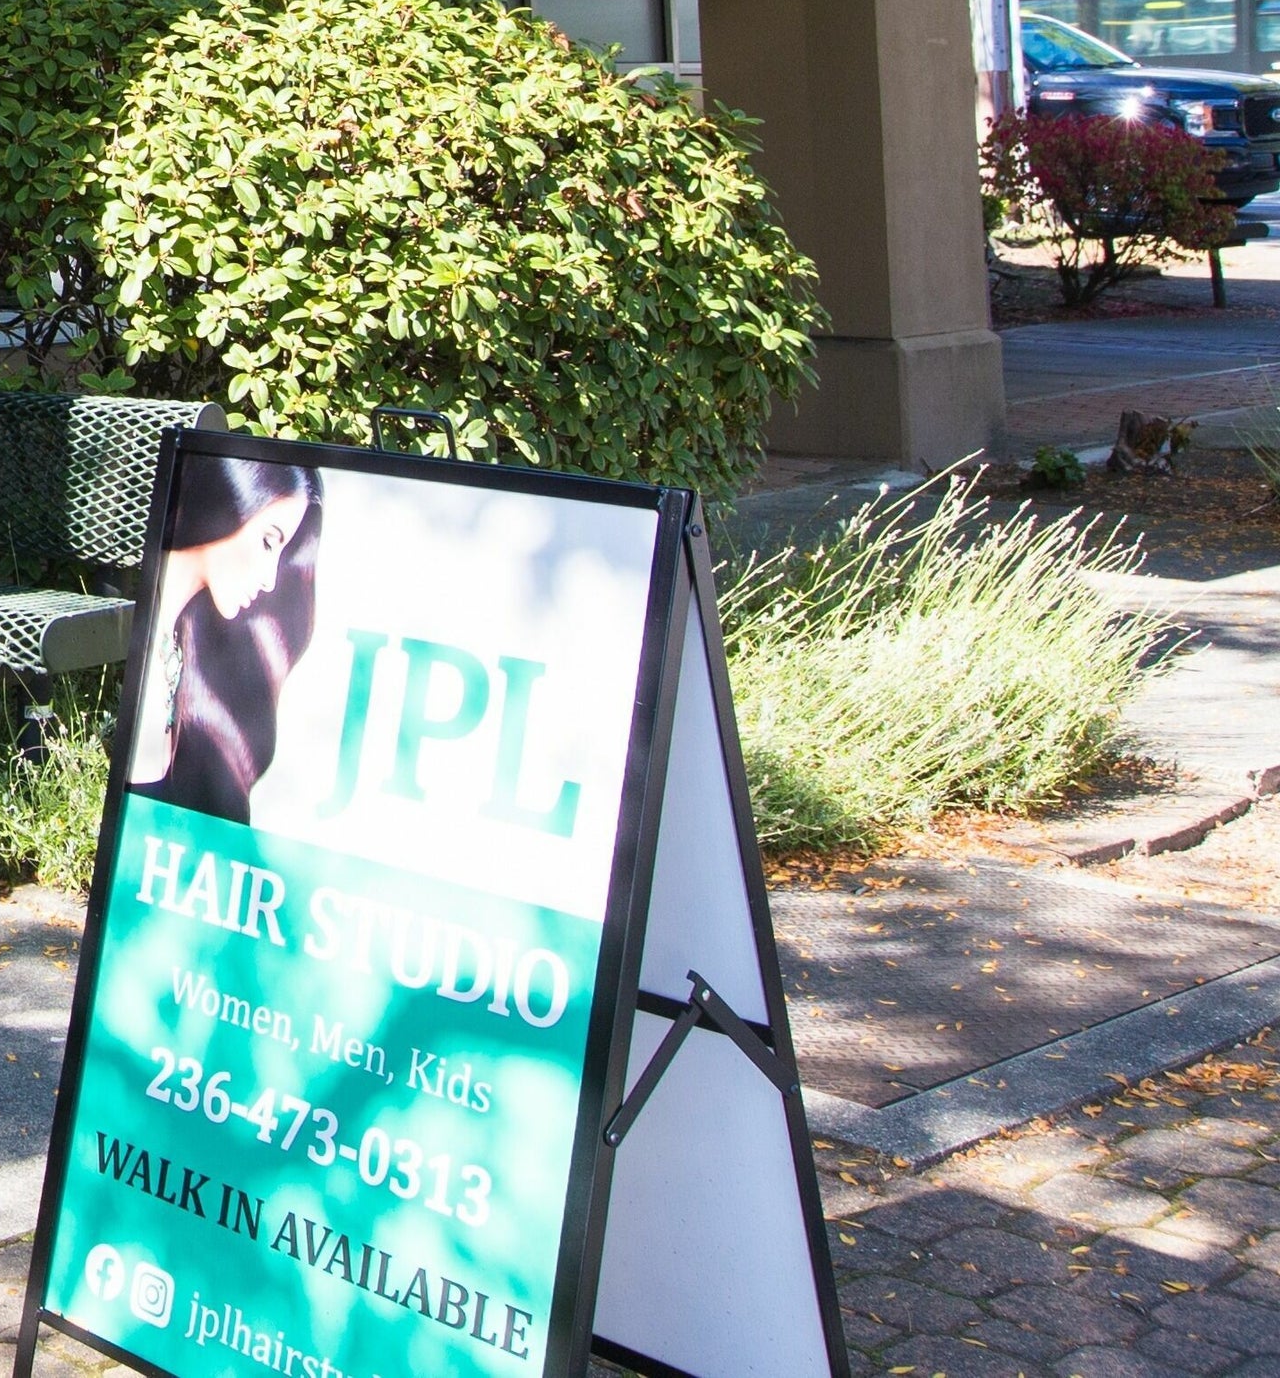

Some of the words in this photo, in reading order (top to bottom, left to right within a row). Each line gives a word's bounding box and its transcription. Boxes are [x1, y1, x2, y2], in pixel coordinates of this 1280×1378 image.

[317, 626, 583, 839] JPL
[135, 837, 287, 948] HAIR
[303, 884, 571, 1029] STUDIO
[145, 1044, 494, 1228] 236-473-0313
[171, 966, 300, 1056] Women,
[309, 1023, 395, 1086] Men,
[407, 1049, 492, 1115] Kids
[95, 1130, 208, 1219] WALK
[217, 1184, 266, 1243] IN
[270, 1210, 535, 1362] AVAILABLE
